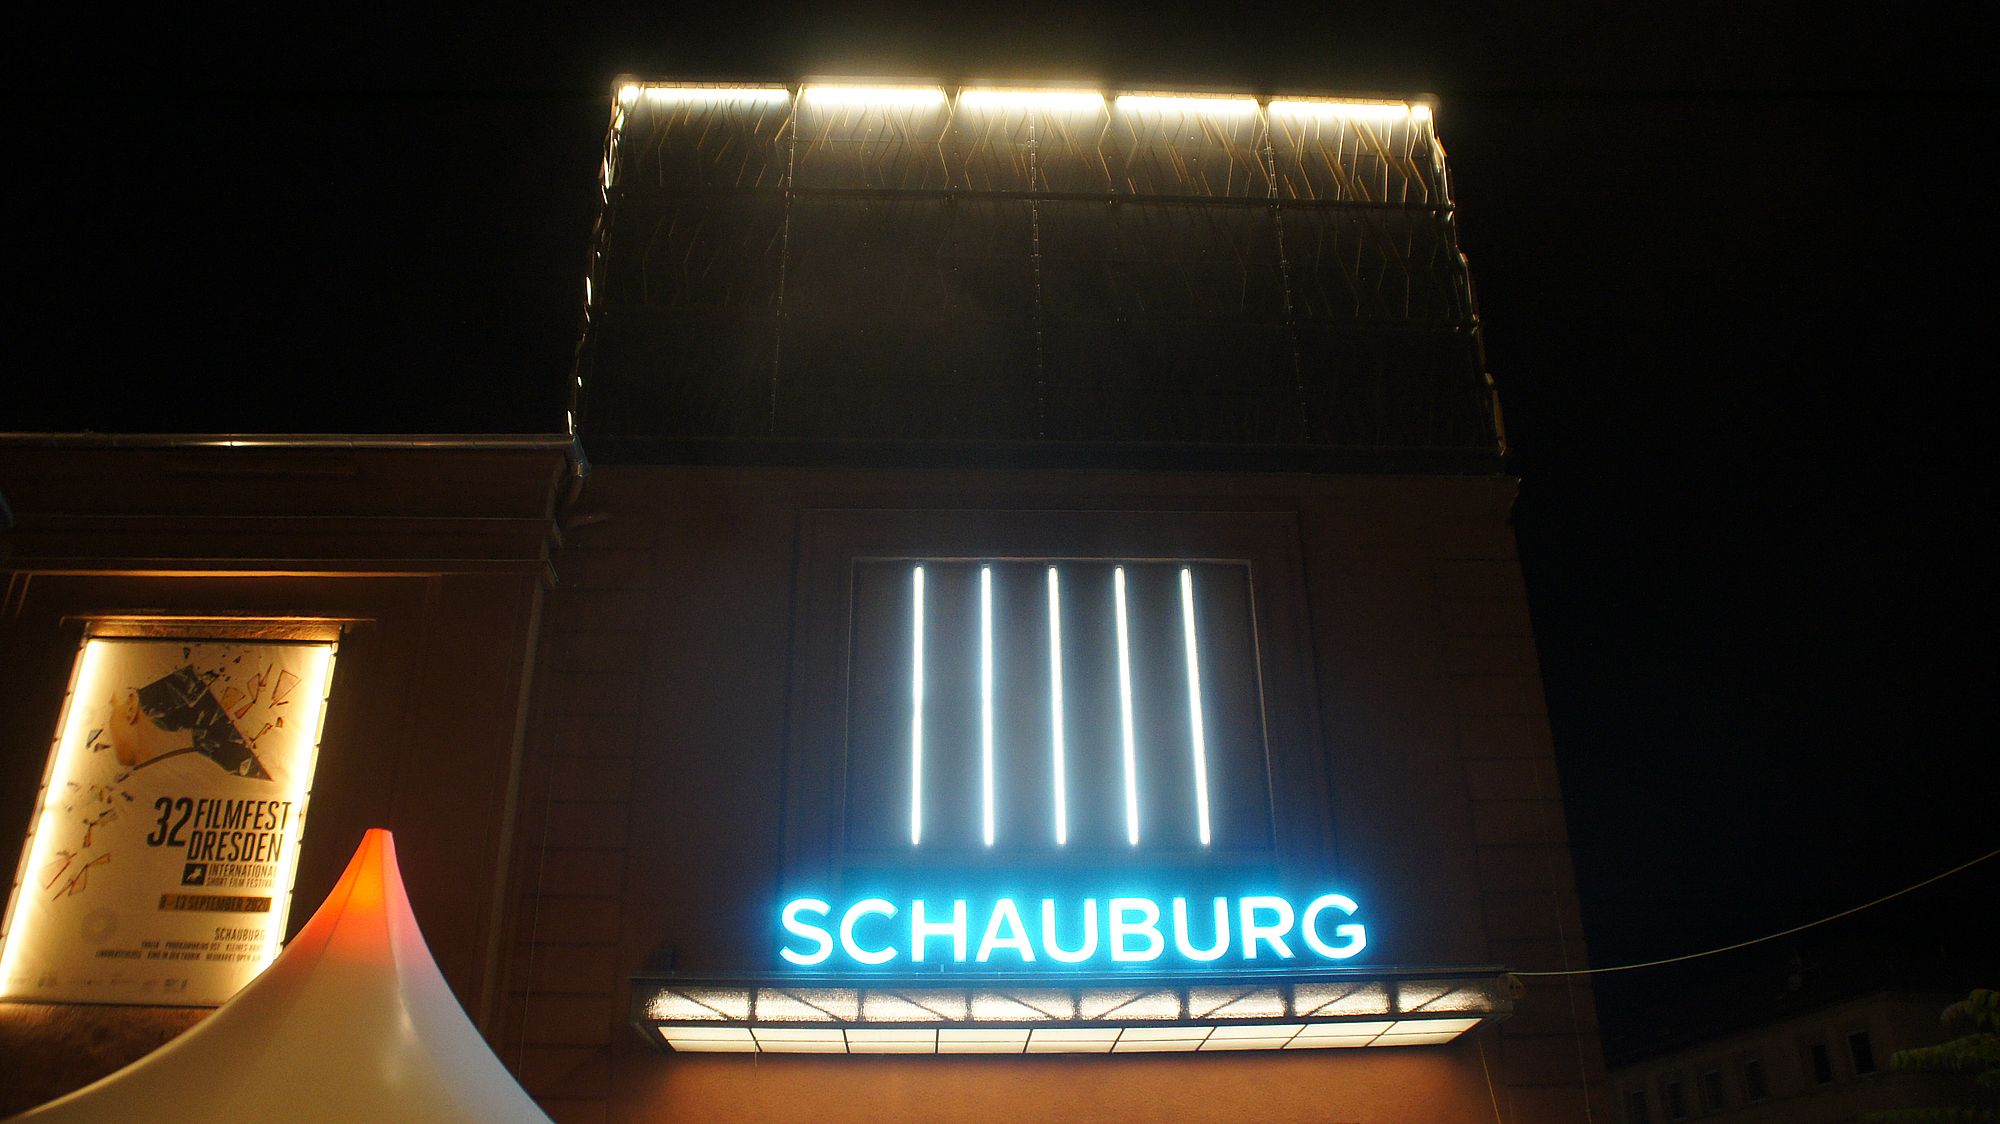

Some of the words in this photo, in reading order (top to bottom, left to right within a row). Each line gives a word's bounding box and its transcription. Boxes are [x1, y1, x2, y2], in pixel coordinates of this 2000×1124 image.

[146, 796, 194, 848] 32
[193, 799, 292, 831] FILMFEST
[187, 830, 283, 862] DRESDEN
[214, 927, 265, 941] SCHAUBURG
[779, 893, 1368, 966] SCHAUBURG
